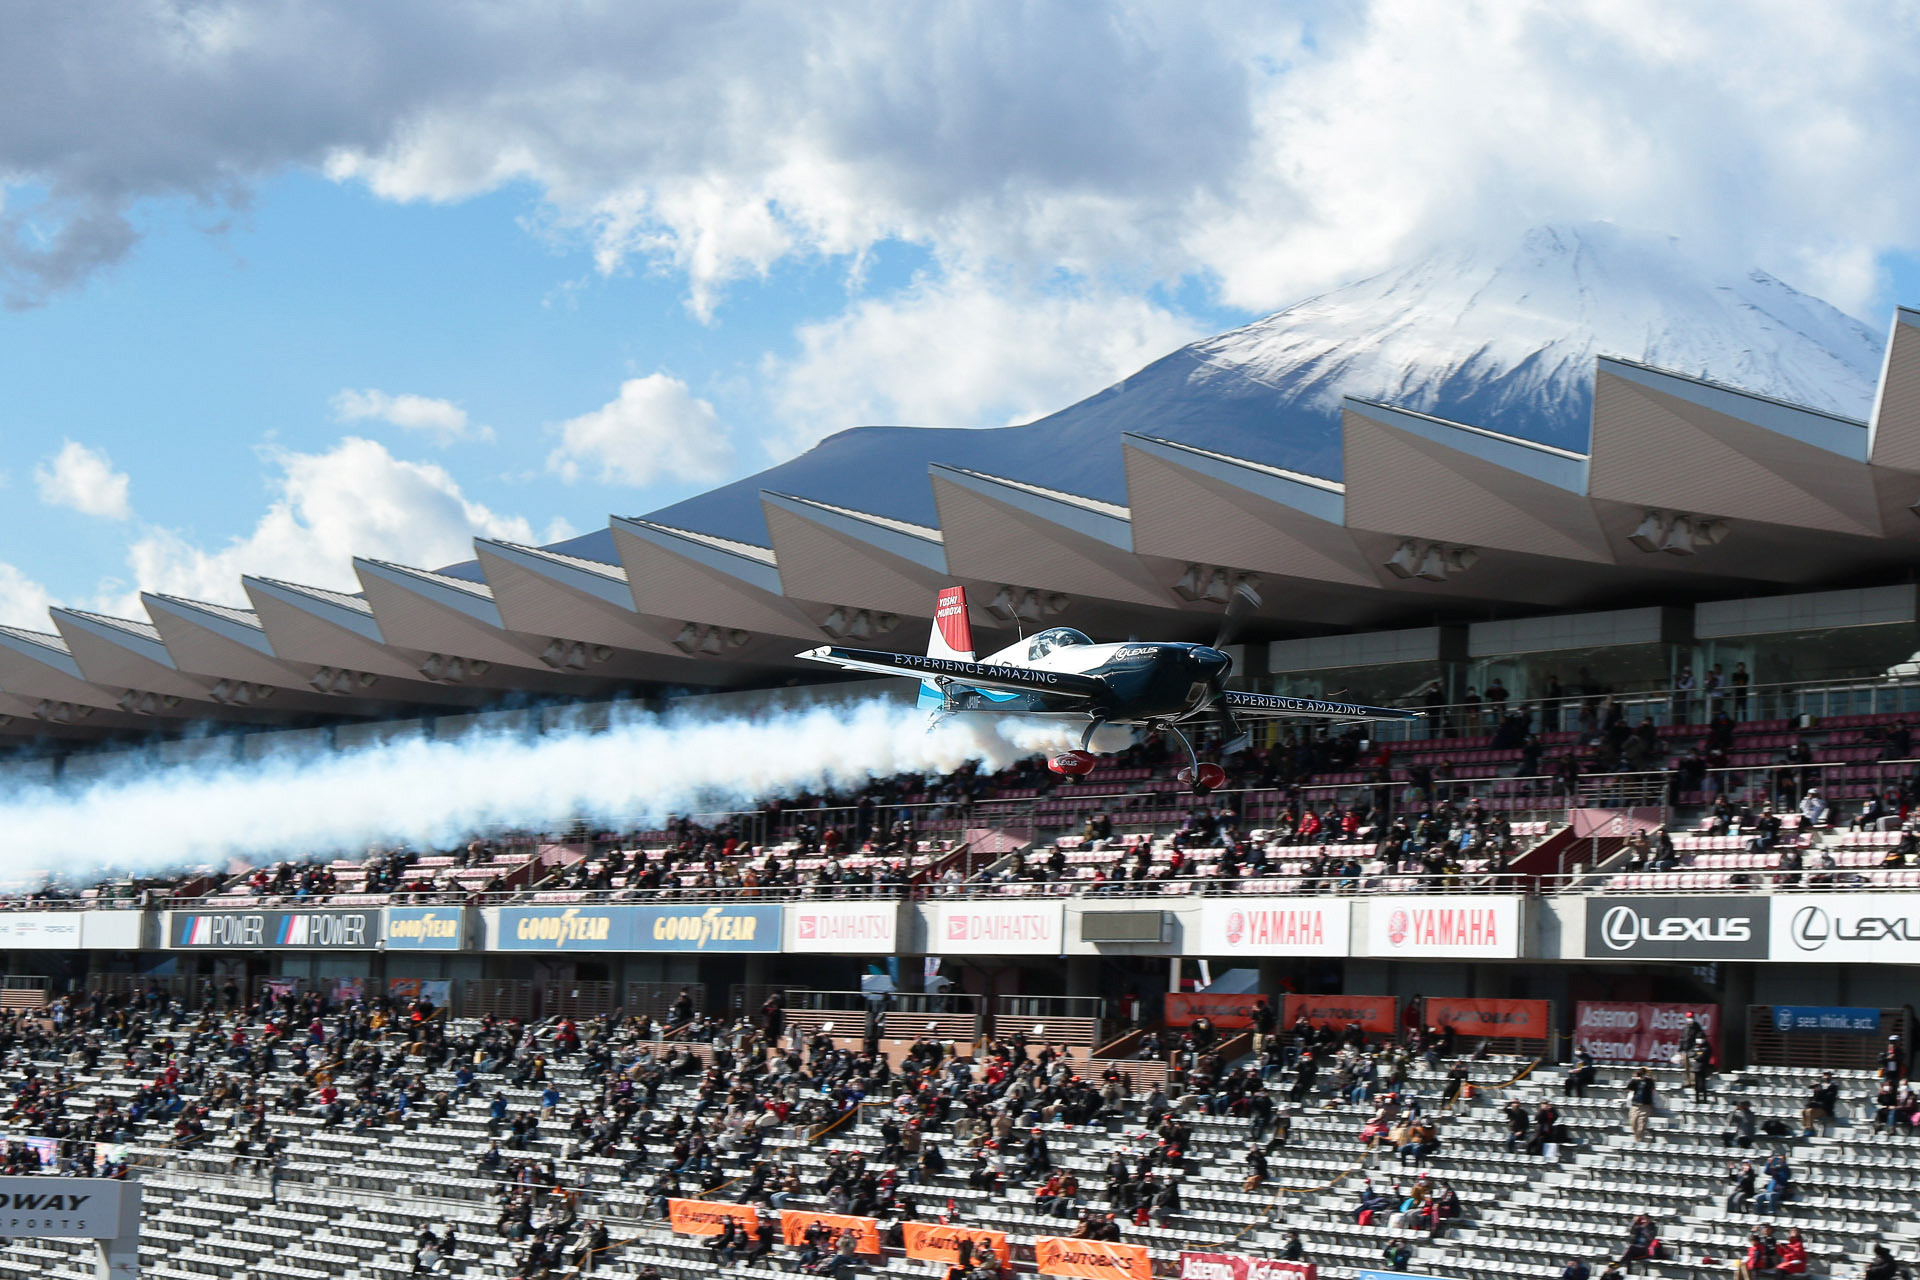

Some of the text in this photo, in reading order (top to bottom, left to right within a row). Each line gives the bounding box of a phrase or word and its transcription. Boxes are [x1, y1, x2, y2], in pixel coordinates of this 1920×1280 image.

[937, 605, 962, 618] MUROYA
[940, 595, 958, 608] YOSHI
[1127, 646, 1158, 657] LEXUS
[894, 653, 985, 676] EXPERIENCE
[988, 665, 1058, 684] AMAZING
[1226, 692, 1367, 716] EXPERIENCE AMAZING
[213, 915, 264, 945] POWER
[310, 914, 366, 946] POWER
[390, 914, 457, 942] GOODYEAR
[517, 909, 610, 947] GOODYEAR
[653, 908, 757, 948] GOODYEAR
[819, 915, 890, 939] DAIHATSU
[970, 915, 1049, 940] DAIHATSU
[1248, 910, 1324, 945] YAMAHA
[1412, 909, 1497, 946] YAMAHA
[1640, 916, 1751, 941] LEXUS
[1187, 1005, 1251, 1017] AUTOBAC
[1581, 1006, 1639, 1028] Astemo
[1063, 1252, 1133, 1269] AUTOBACS
[1181, 1257, 1235, 1280] Astemo
